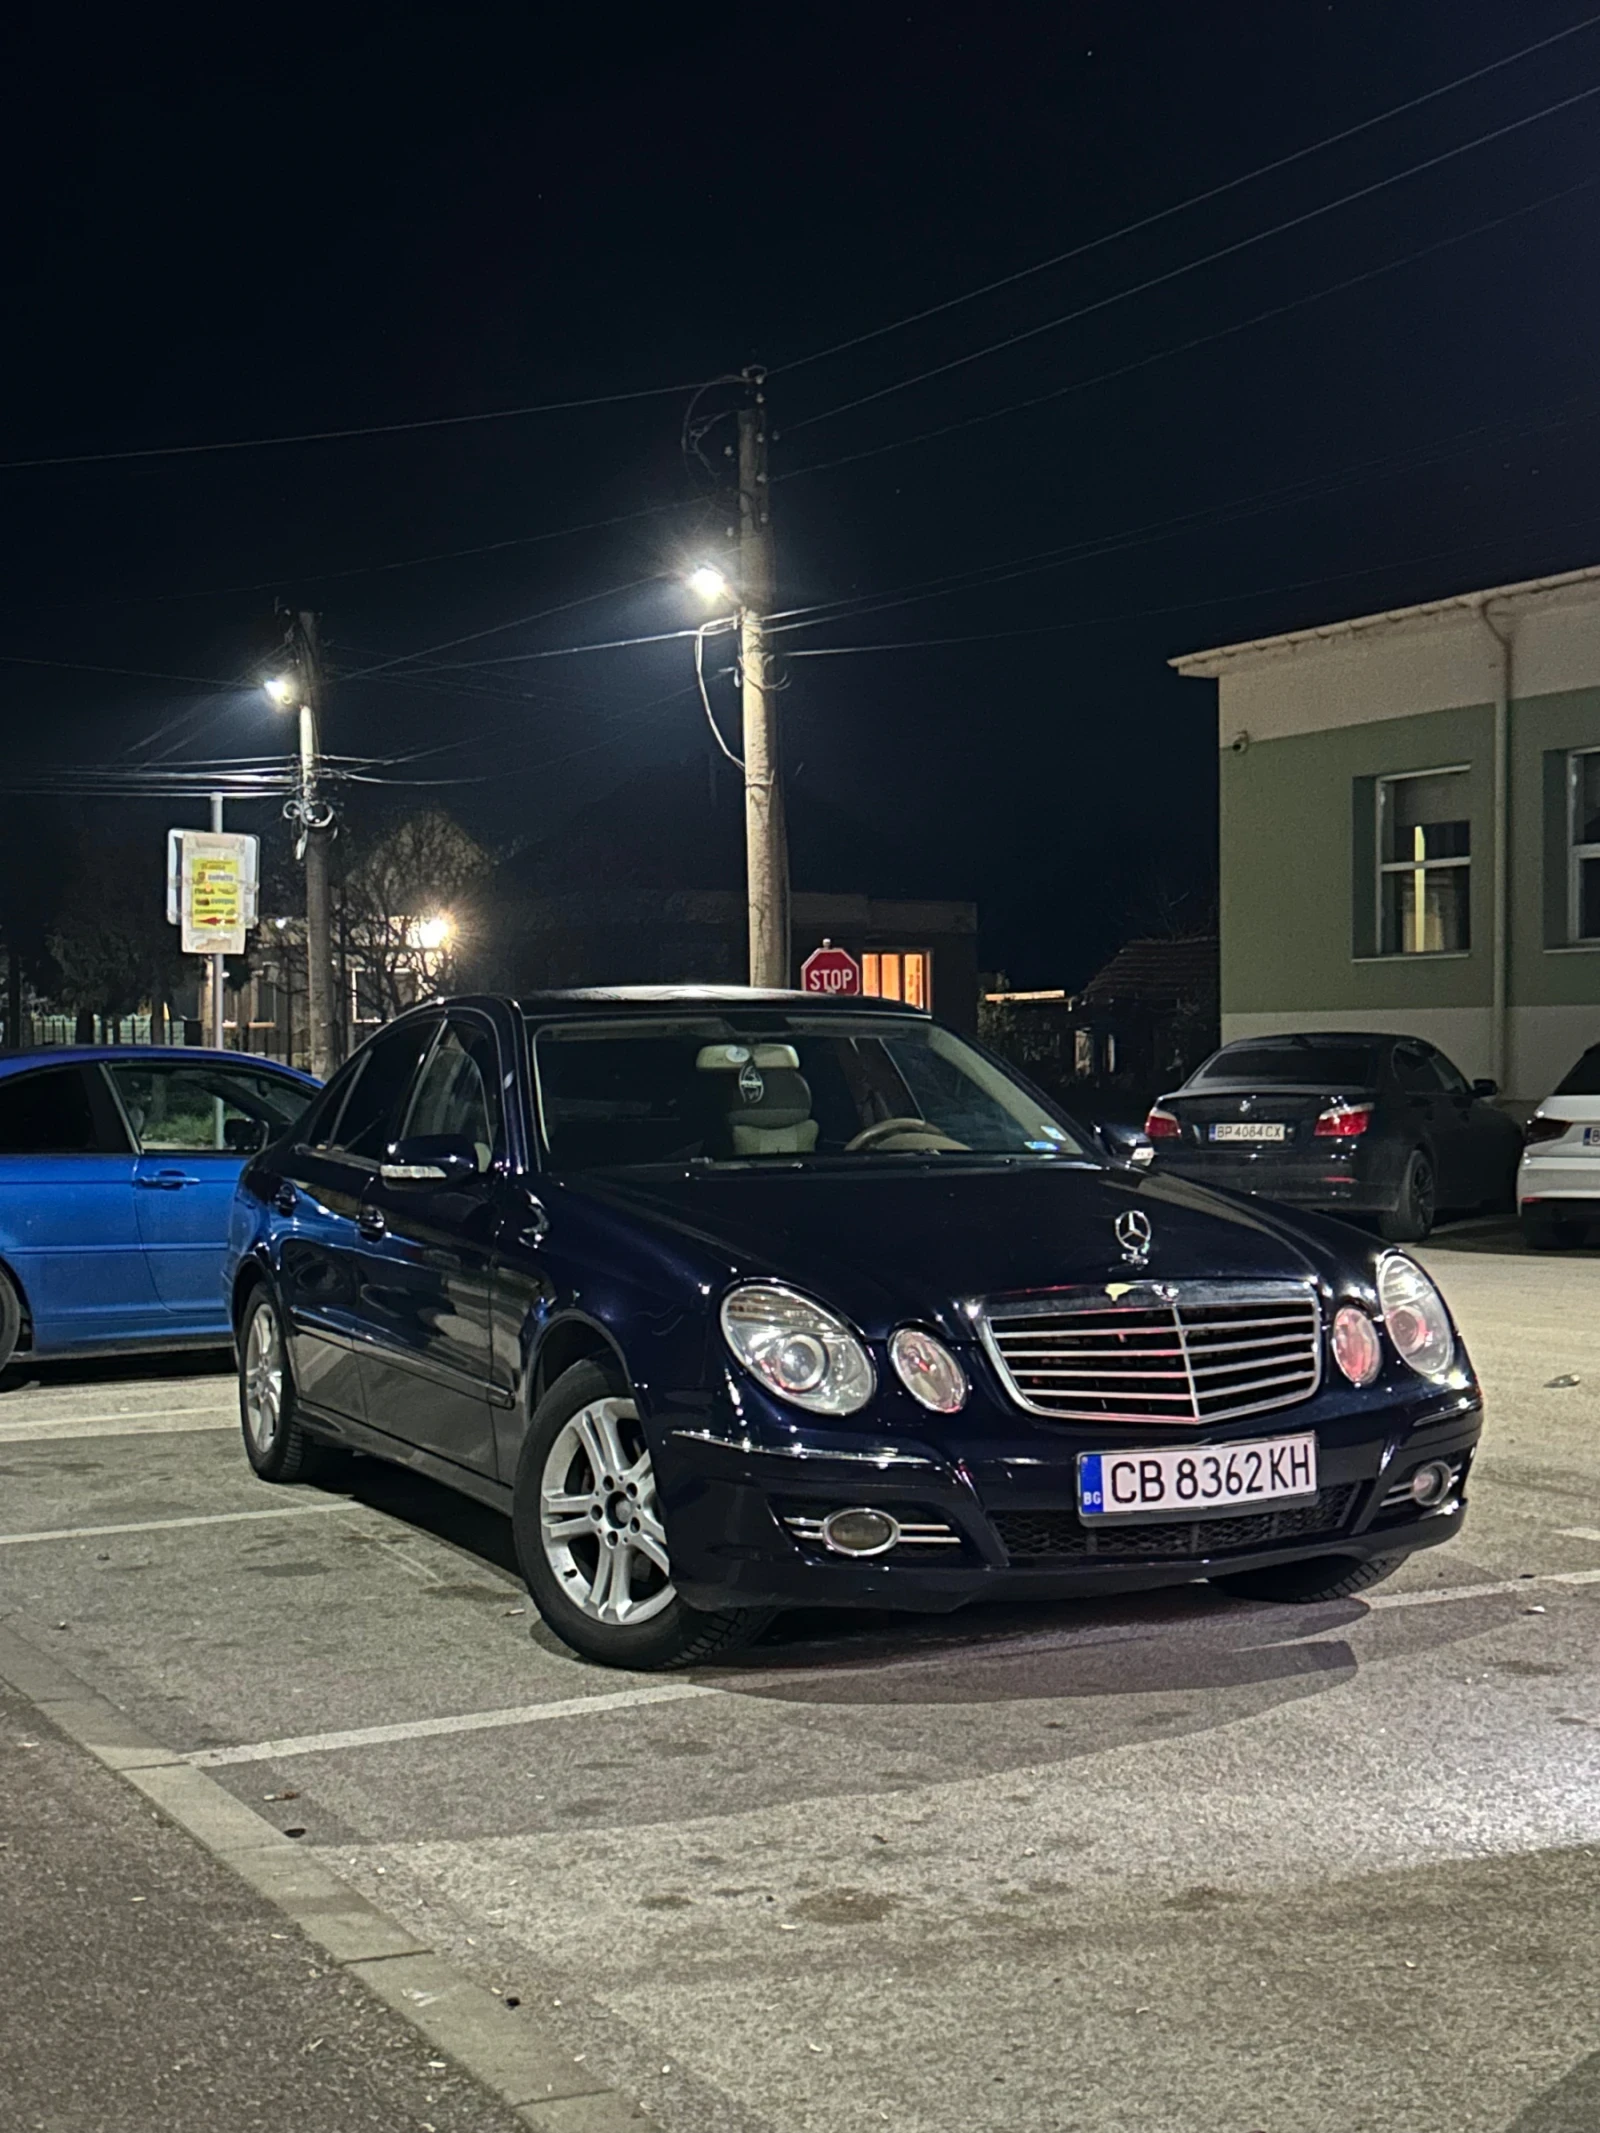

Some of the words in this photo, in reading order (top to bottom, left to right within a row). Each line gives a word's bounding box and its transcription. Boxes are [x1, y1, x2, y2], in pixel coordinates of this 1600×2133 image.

[810, 969, 853, 990] STOP
[1111, 1460, 1165, 1504] CB
[1176, 1451, 1263, 1499] 8362
[1269, 1444, 1310, 1491] KH
[1083, 1491, 1102, 1505] BG
